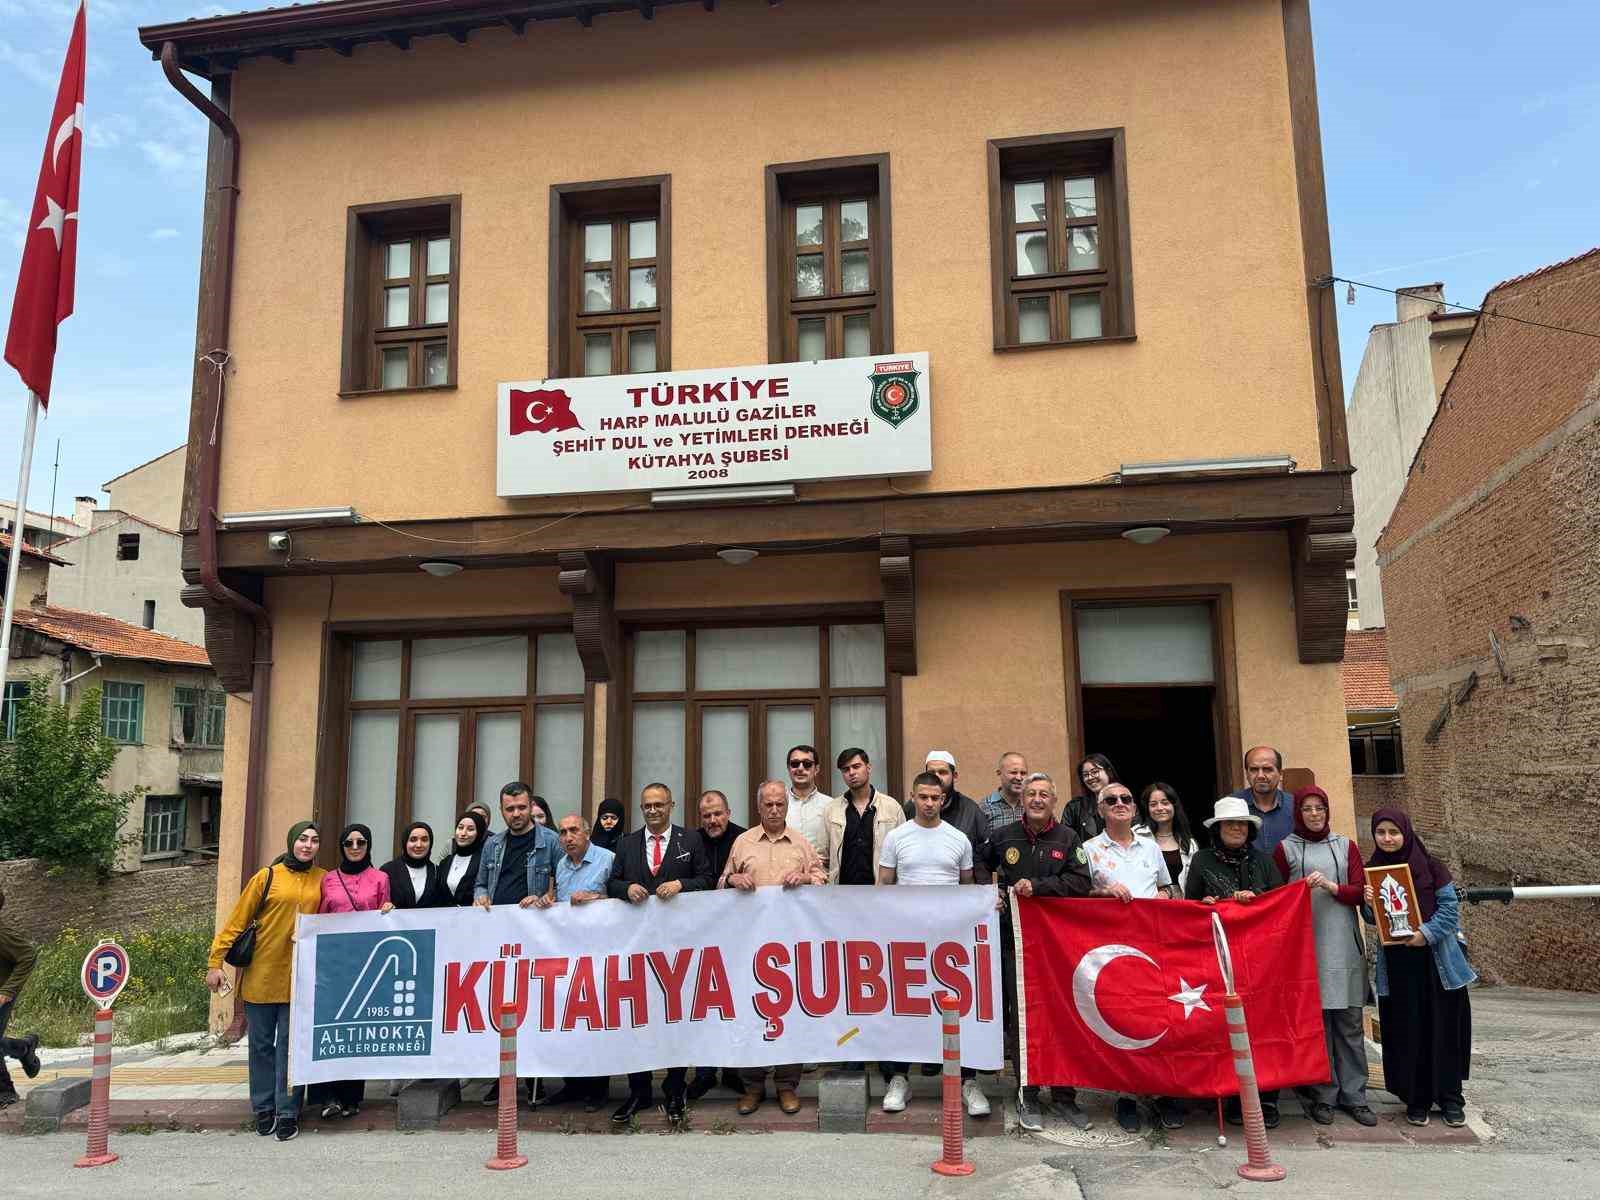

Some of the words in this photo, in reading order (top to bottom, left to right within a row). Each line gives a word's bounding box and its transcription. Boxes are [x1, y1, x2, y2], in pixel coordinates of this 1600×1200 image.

[626, 376, 789, 408] TÜRKİYE
[600, 415, 649, 430] HARP
[655, 408, 730, 427] MALULÜ
[736, 403, 816, 421] GAZİLER
[552, 436, 606, 456] ŞEHİT
[612, 436, 648, 450] DUL
[653, 437, 673, 448] ve
[680, 424, 778, 445] YETİMLERİ
[785, 418, 869, 439] DERNEĞİ
[628, 452, 715, 470] KÜTAHYA
[721, 445, 789, 467] ŞUBESİ
[688, 468, 729, 479] 2008
[97, 956, 118, 988] P
[442, 943, 736, 1034] KÜTAHYA
[752, 924, 994, 1040] ŞUBESİ
[366, 1006, 390, 1017] 1985
[320, 1025, 425, 1044] ALTINOKTA
